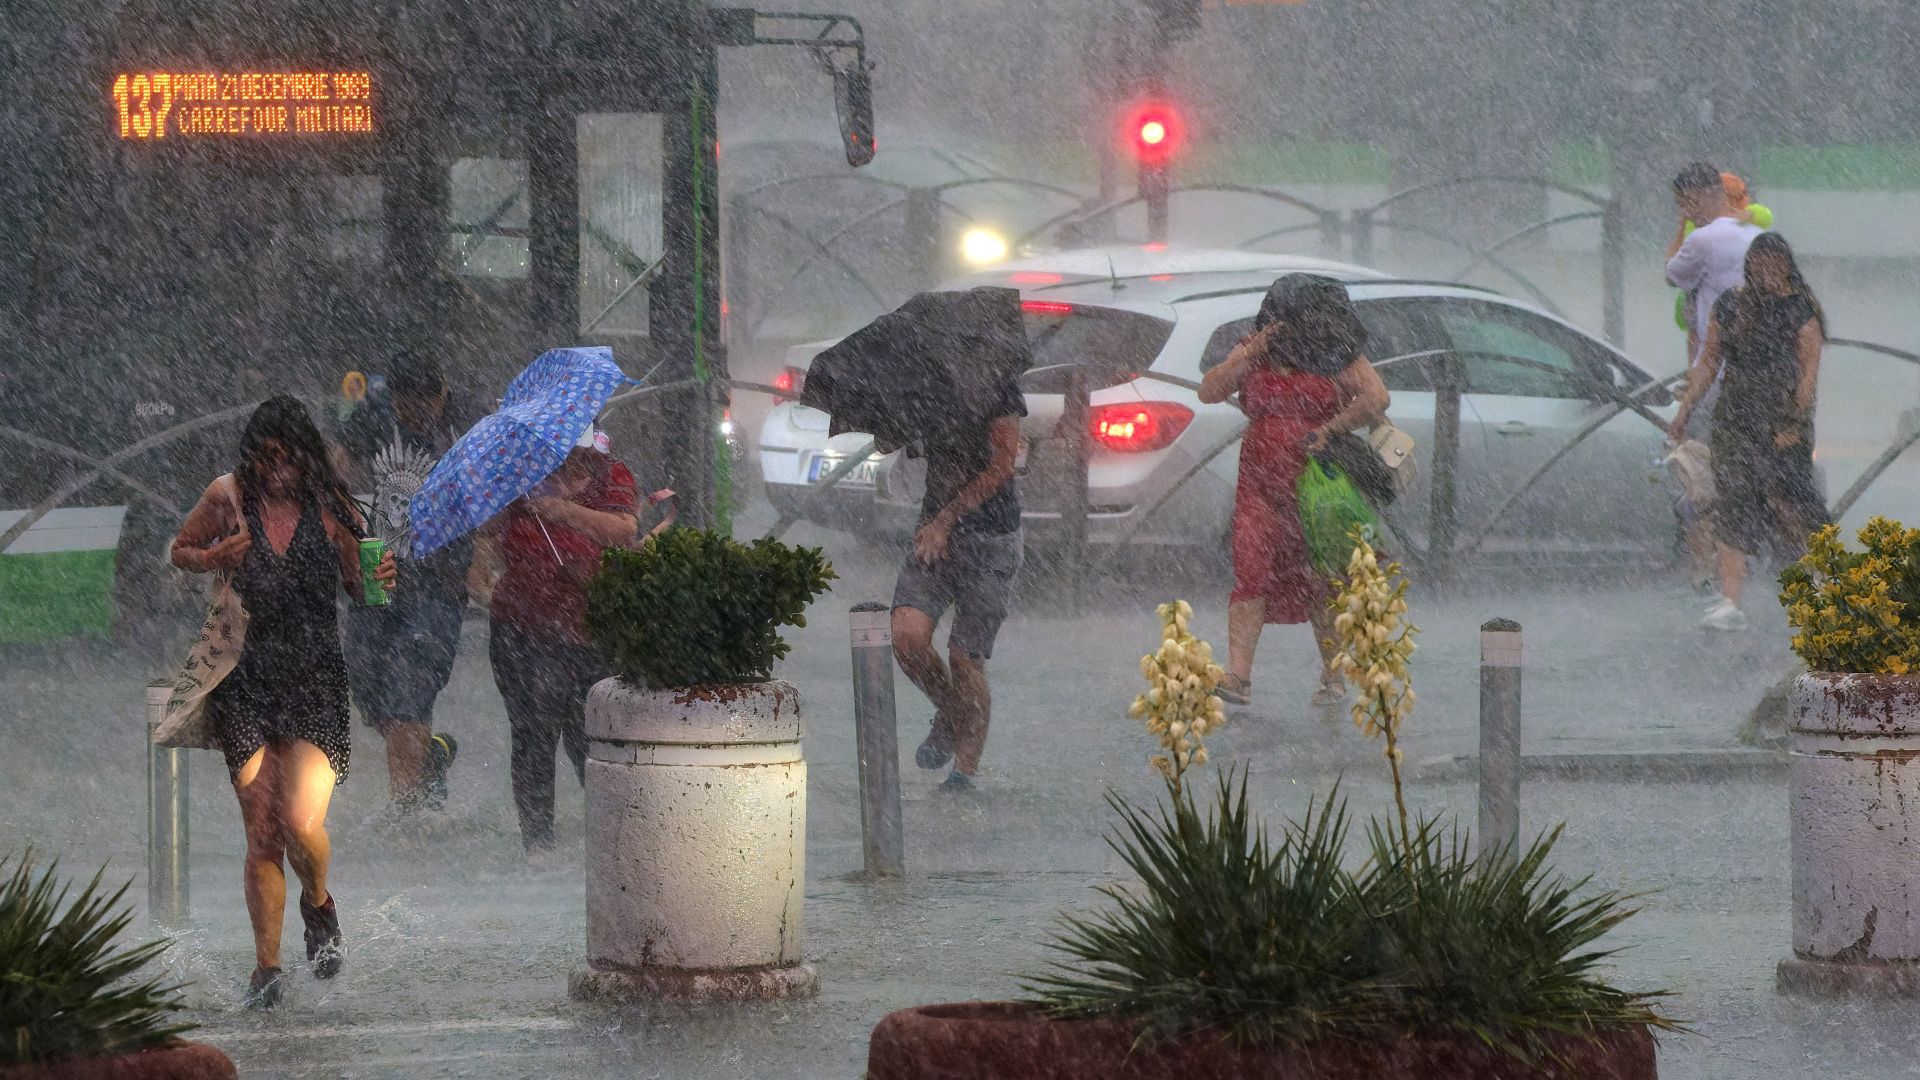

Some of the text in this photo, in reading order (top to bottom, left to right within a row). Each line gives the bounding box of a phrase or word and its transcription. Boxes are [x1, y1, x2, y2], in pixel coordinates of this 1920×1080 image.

[173, 73, 370, 100] PIATA 21 DECEMBRIE 1989
[113, 74, 172, 137] 137
[179, 105, 372, 133] CARREFOUR MILITARI
